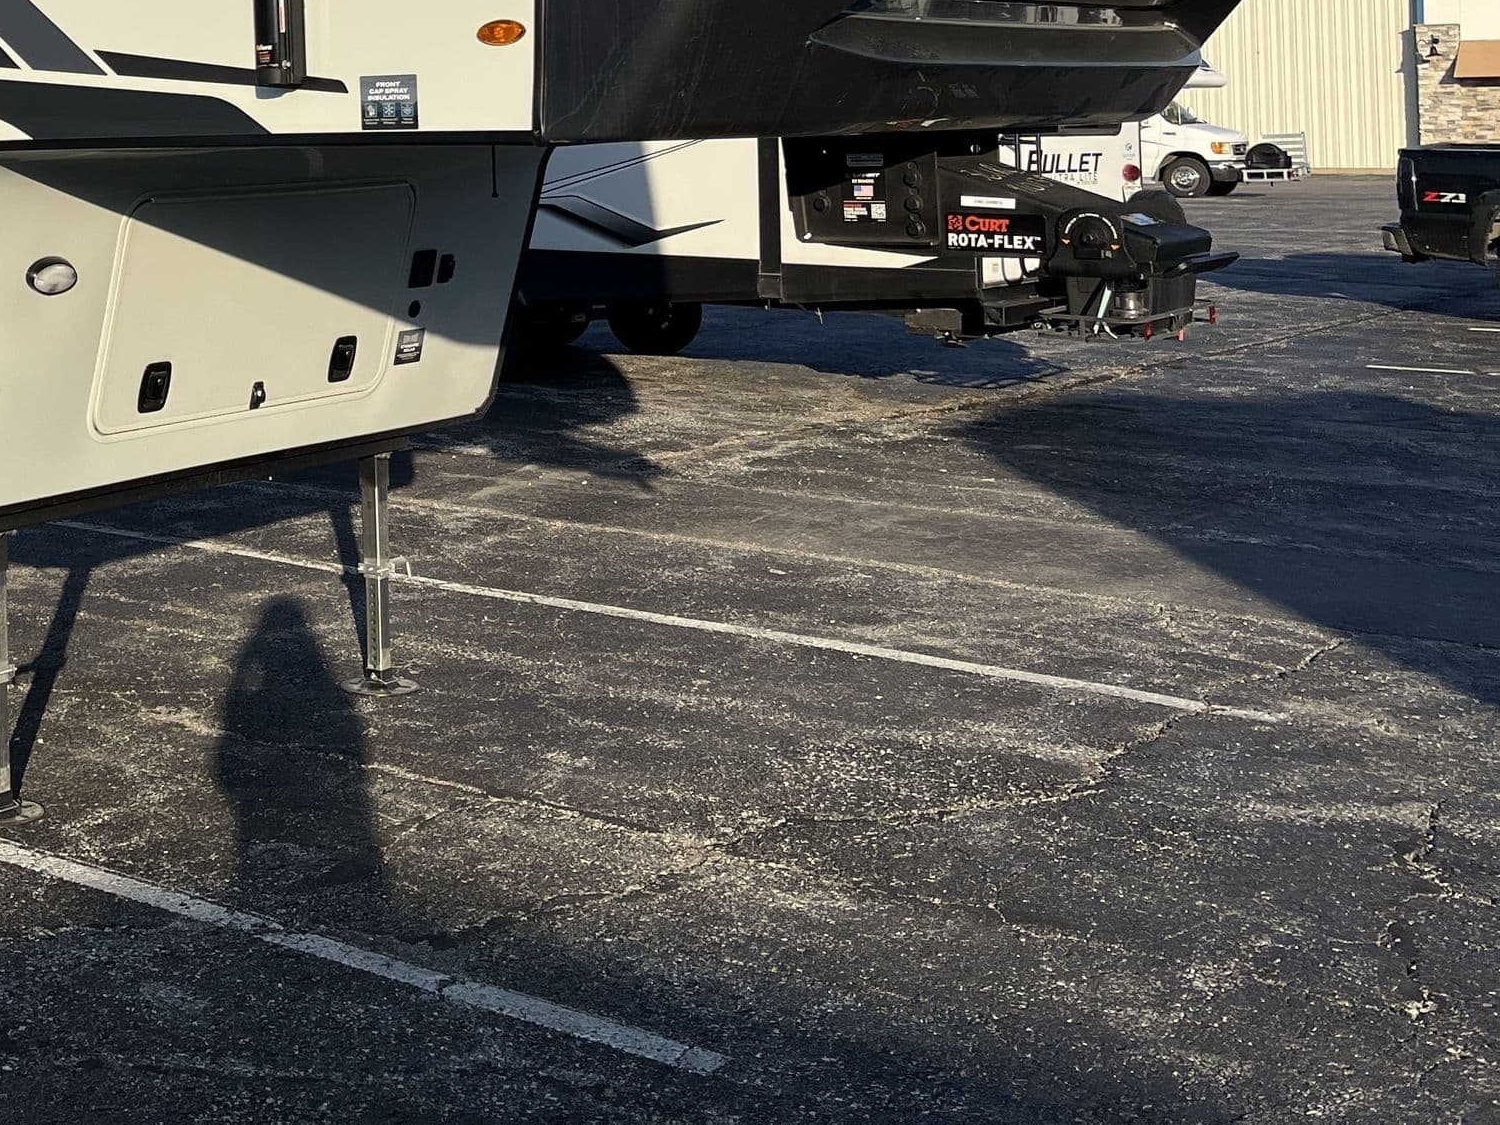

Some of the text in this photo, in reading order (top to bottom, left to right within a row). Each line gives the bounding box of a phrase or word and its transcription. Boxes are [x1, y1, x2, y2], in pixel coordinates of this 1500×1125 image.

[1027, 150, 1103, 174] BULLET
[1422, 191, 1467, 204] Z71
[965, 215, 1010, 232] CURT
